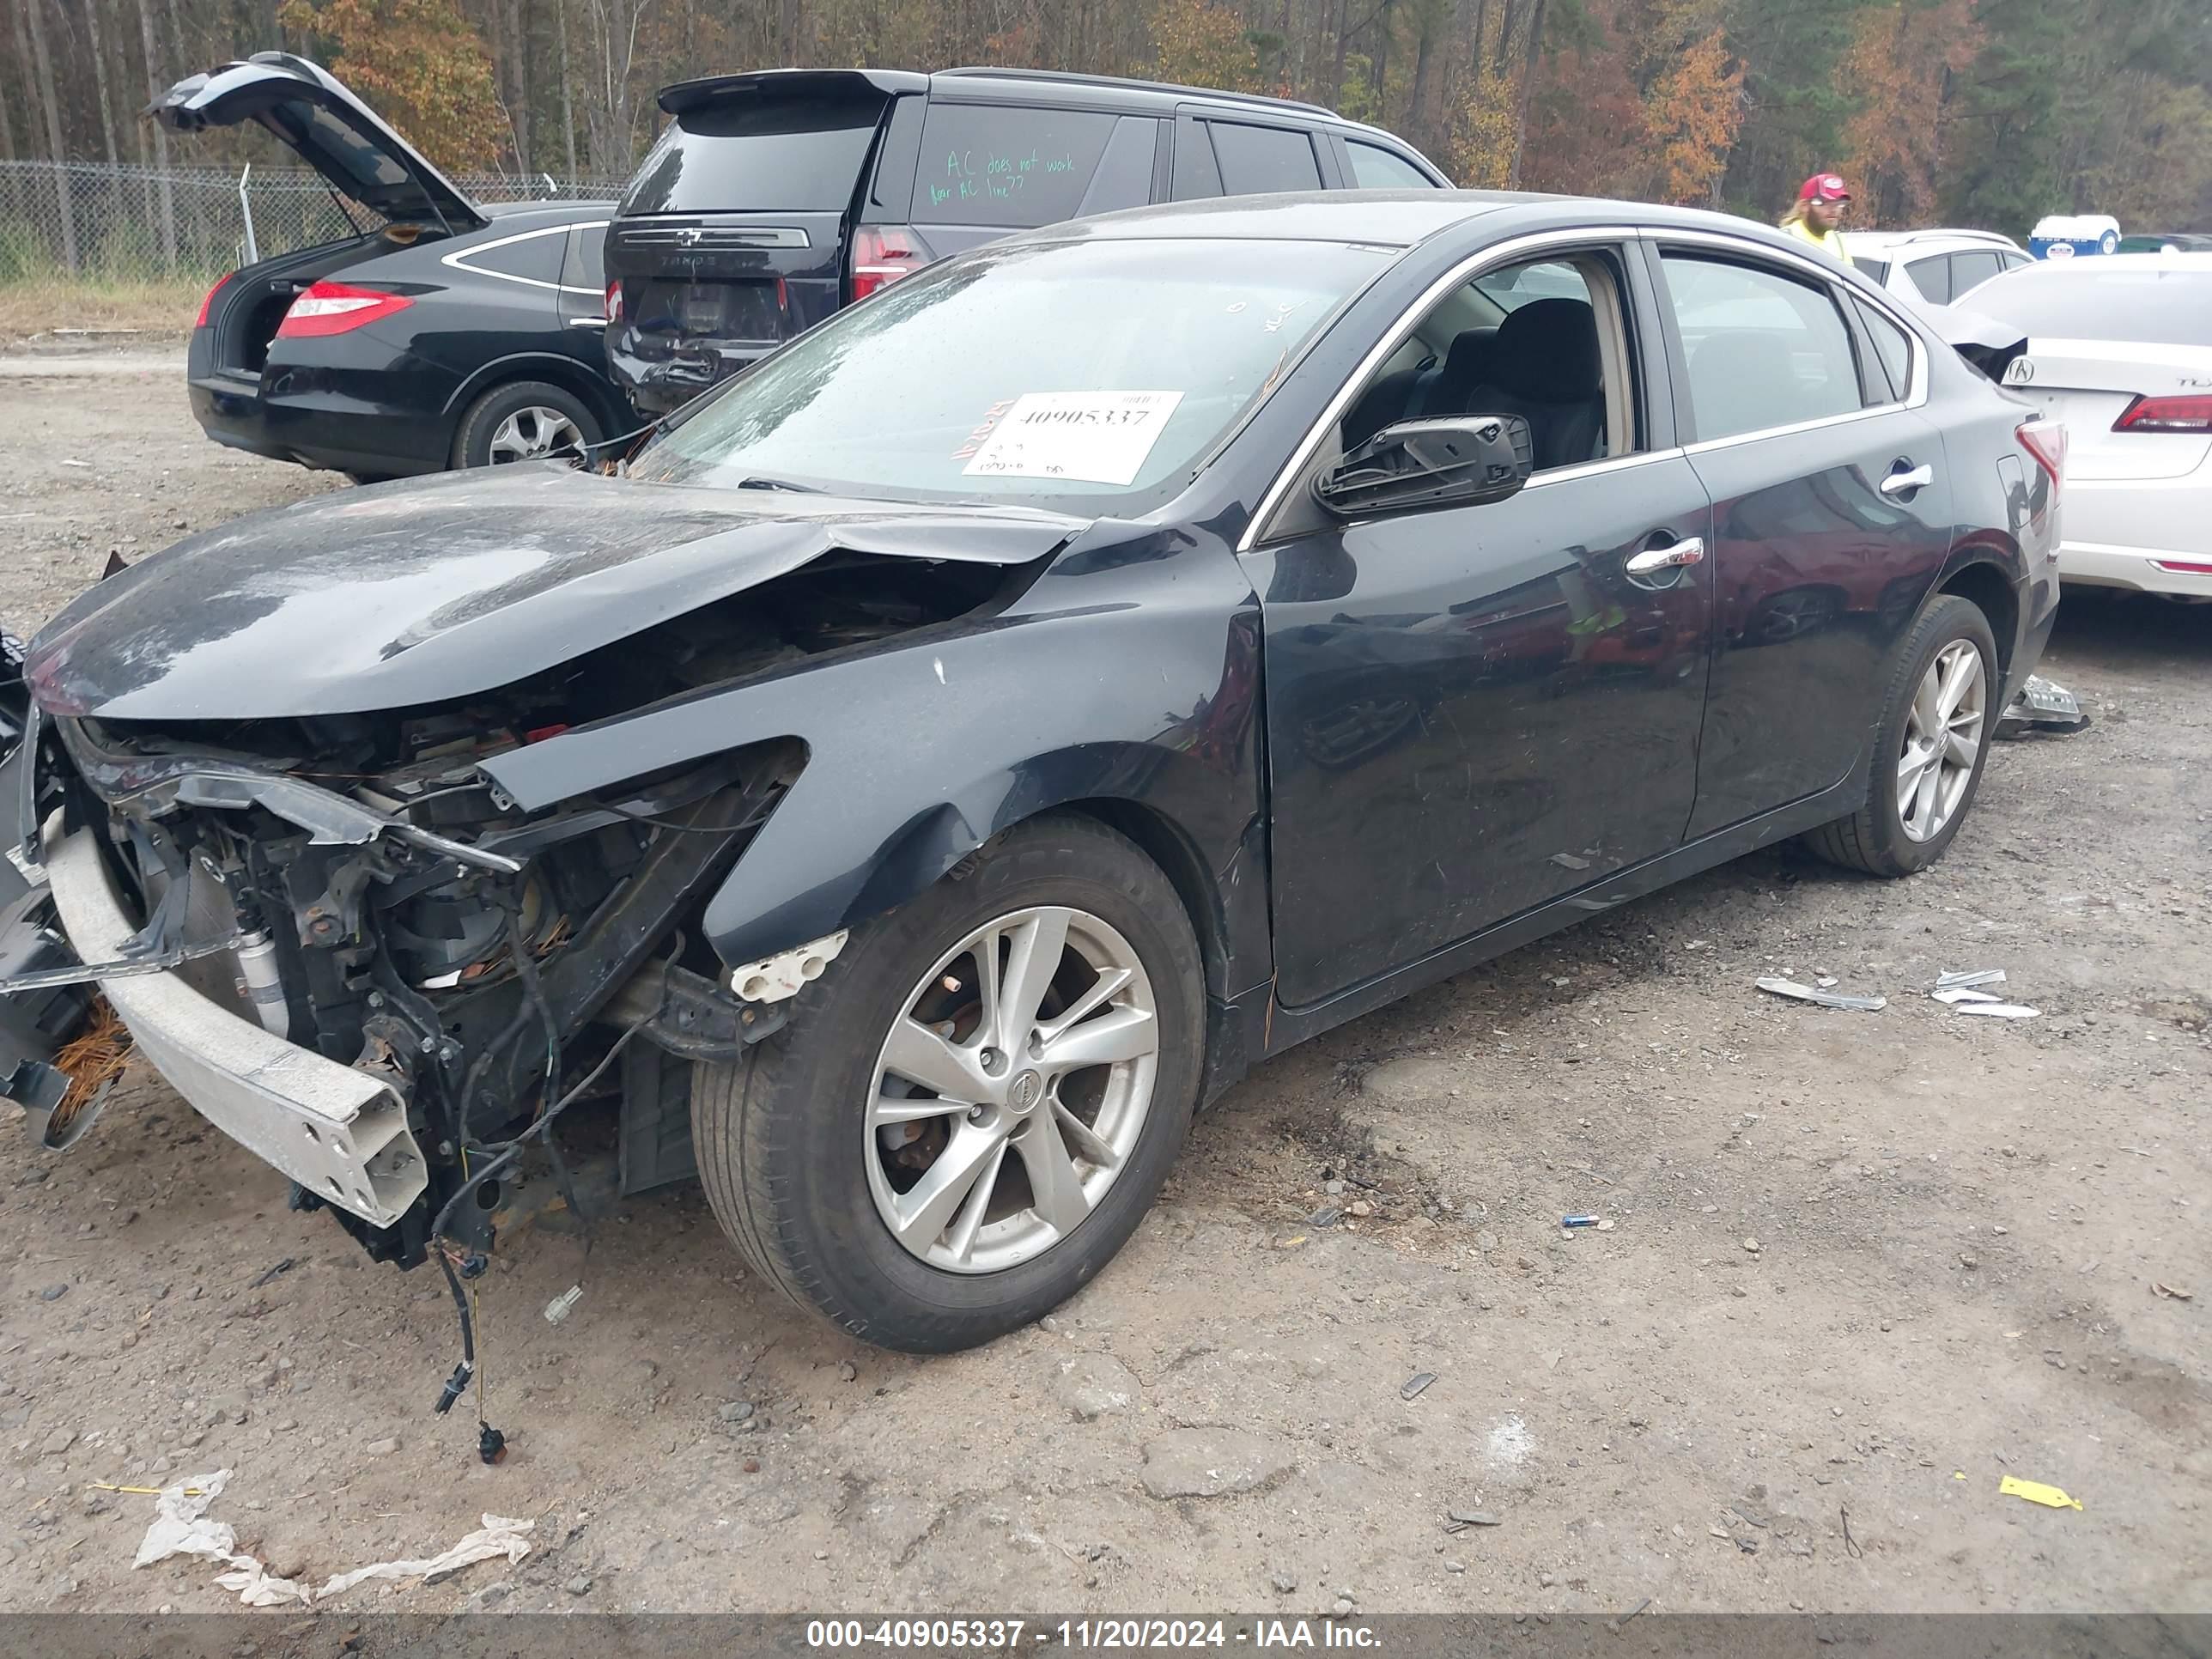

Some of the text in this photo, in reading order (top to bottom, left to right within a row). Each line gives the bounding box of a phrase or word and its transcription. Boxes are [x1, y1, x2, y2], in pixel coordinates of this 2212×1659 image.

[947, 149, 1073, 177] AC does not work
[960, 179, 977, 200] AC
[1019, 410, 1150, 426] 40905337
